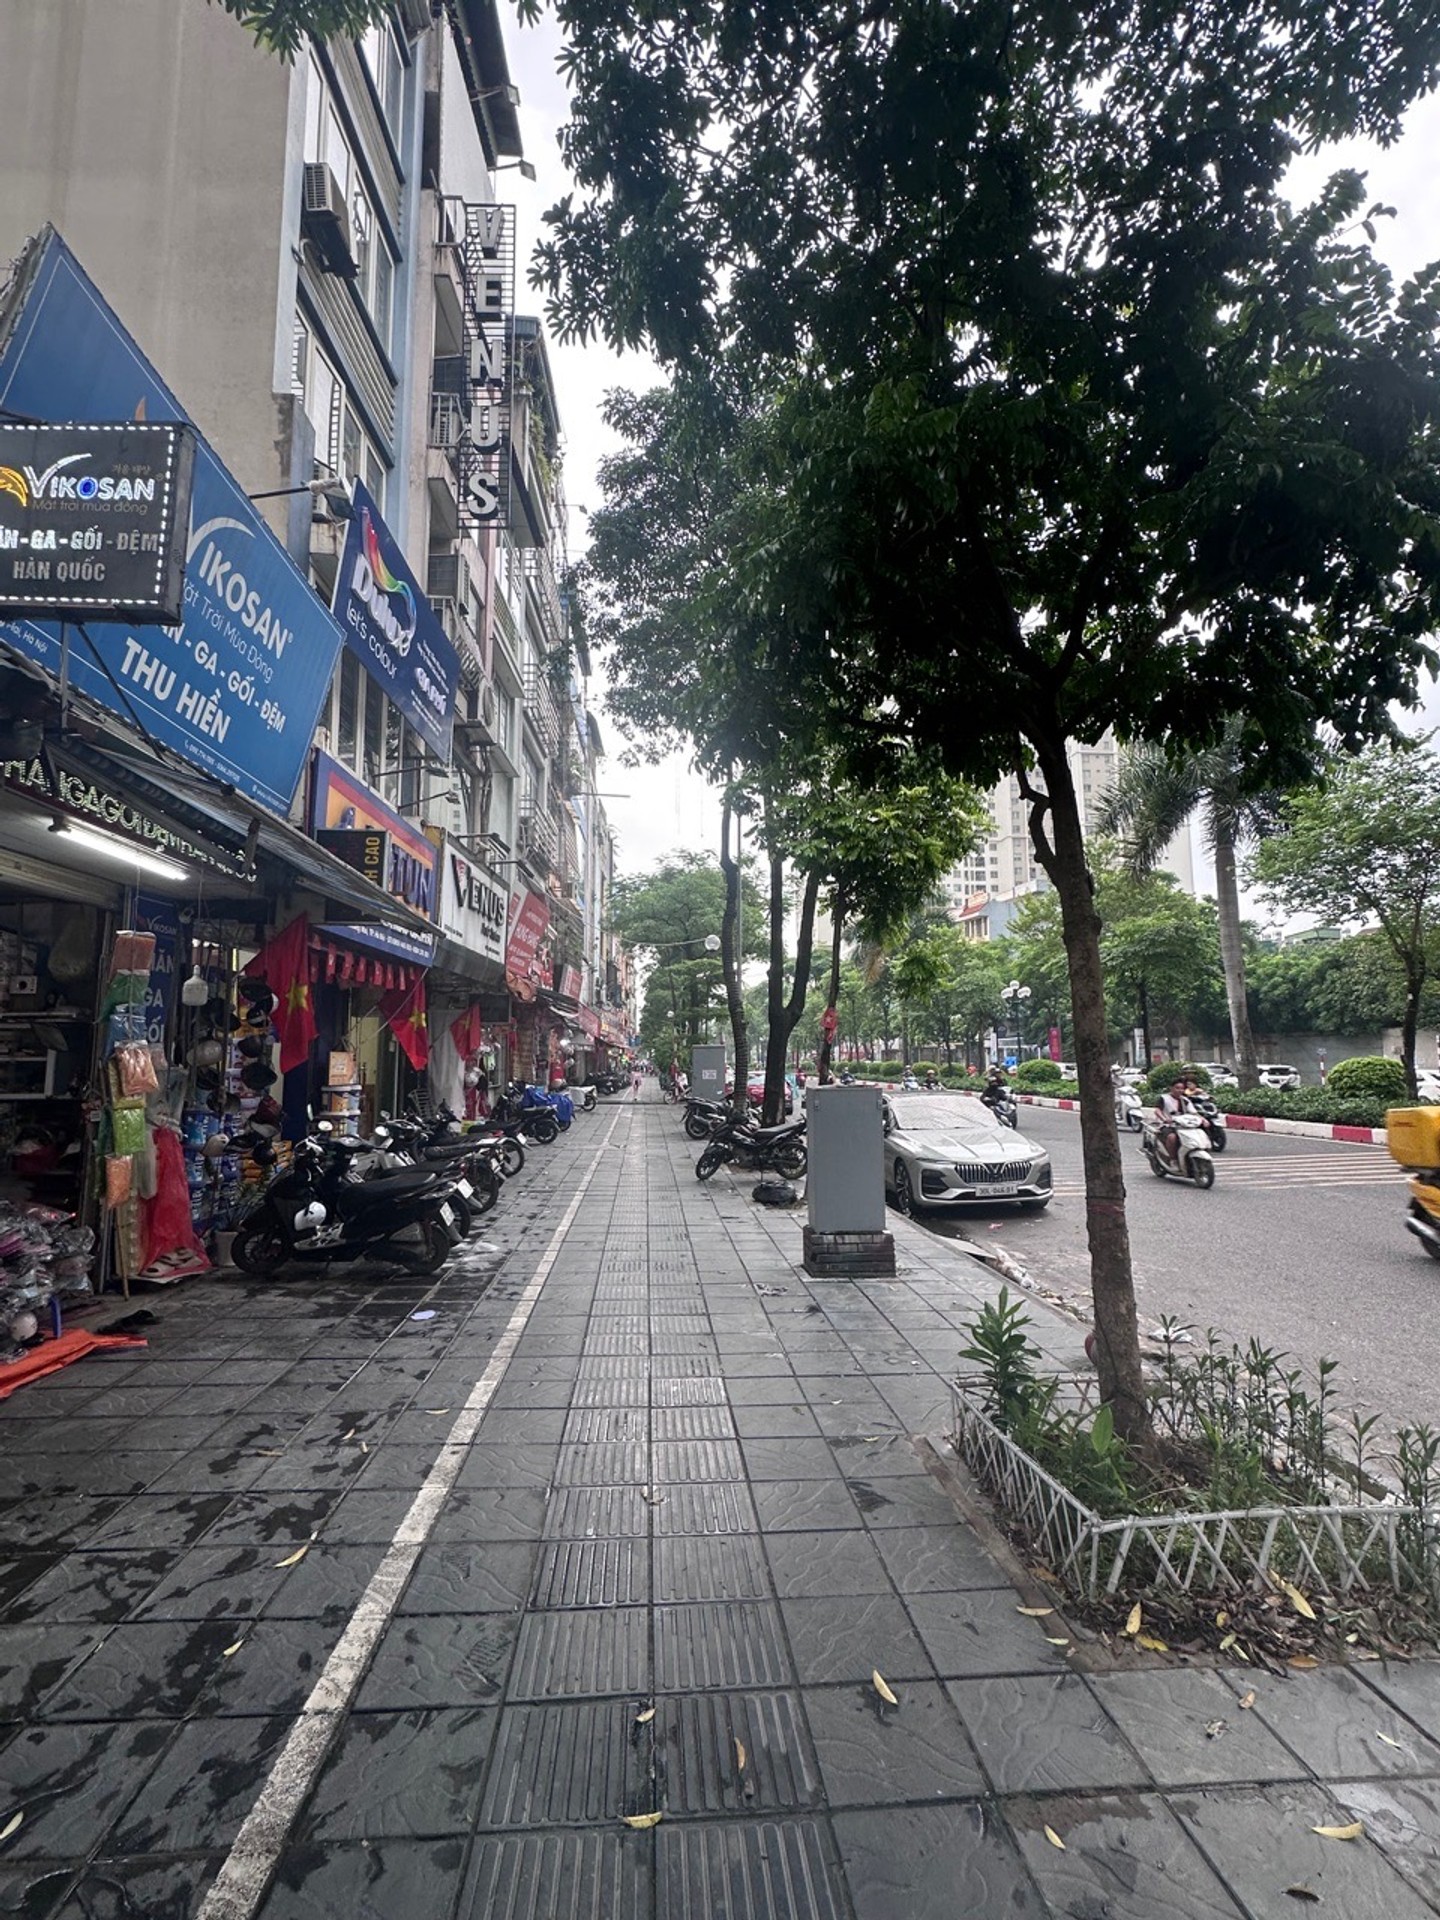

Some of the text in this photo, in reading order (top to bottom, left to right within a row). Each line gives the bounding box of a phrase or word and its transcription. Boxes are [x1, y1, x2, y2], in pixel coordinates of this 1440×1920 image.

[467, 208, 506, 519] VENUS
[22, 452, 155, 501] VIKOSAN
[12, 556, 106, 582] HÀN QUỐC
[30, 530, 56, 549] GA
[70, 524, 103, 550] GỐI
[117, 529, 158, 556] ĐỆM
[345, 598, 399, 681] let's colour
[351, 552, 411, 658] Dulux
[119, 636, 232, 745] THU HIỀN
[194, 640, 219, 677] GA
[227, 670, 256, 707] GỐI
[261, 698, 287, 735] ĐỆM
[364, 836, 381, 864] CAO
[450, 854, 505, 927] VENUS
